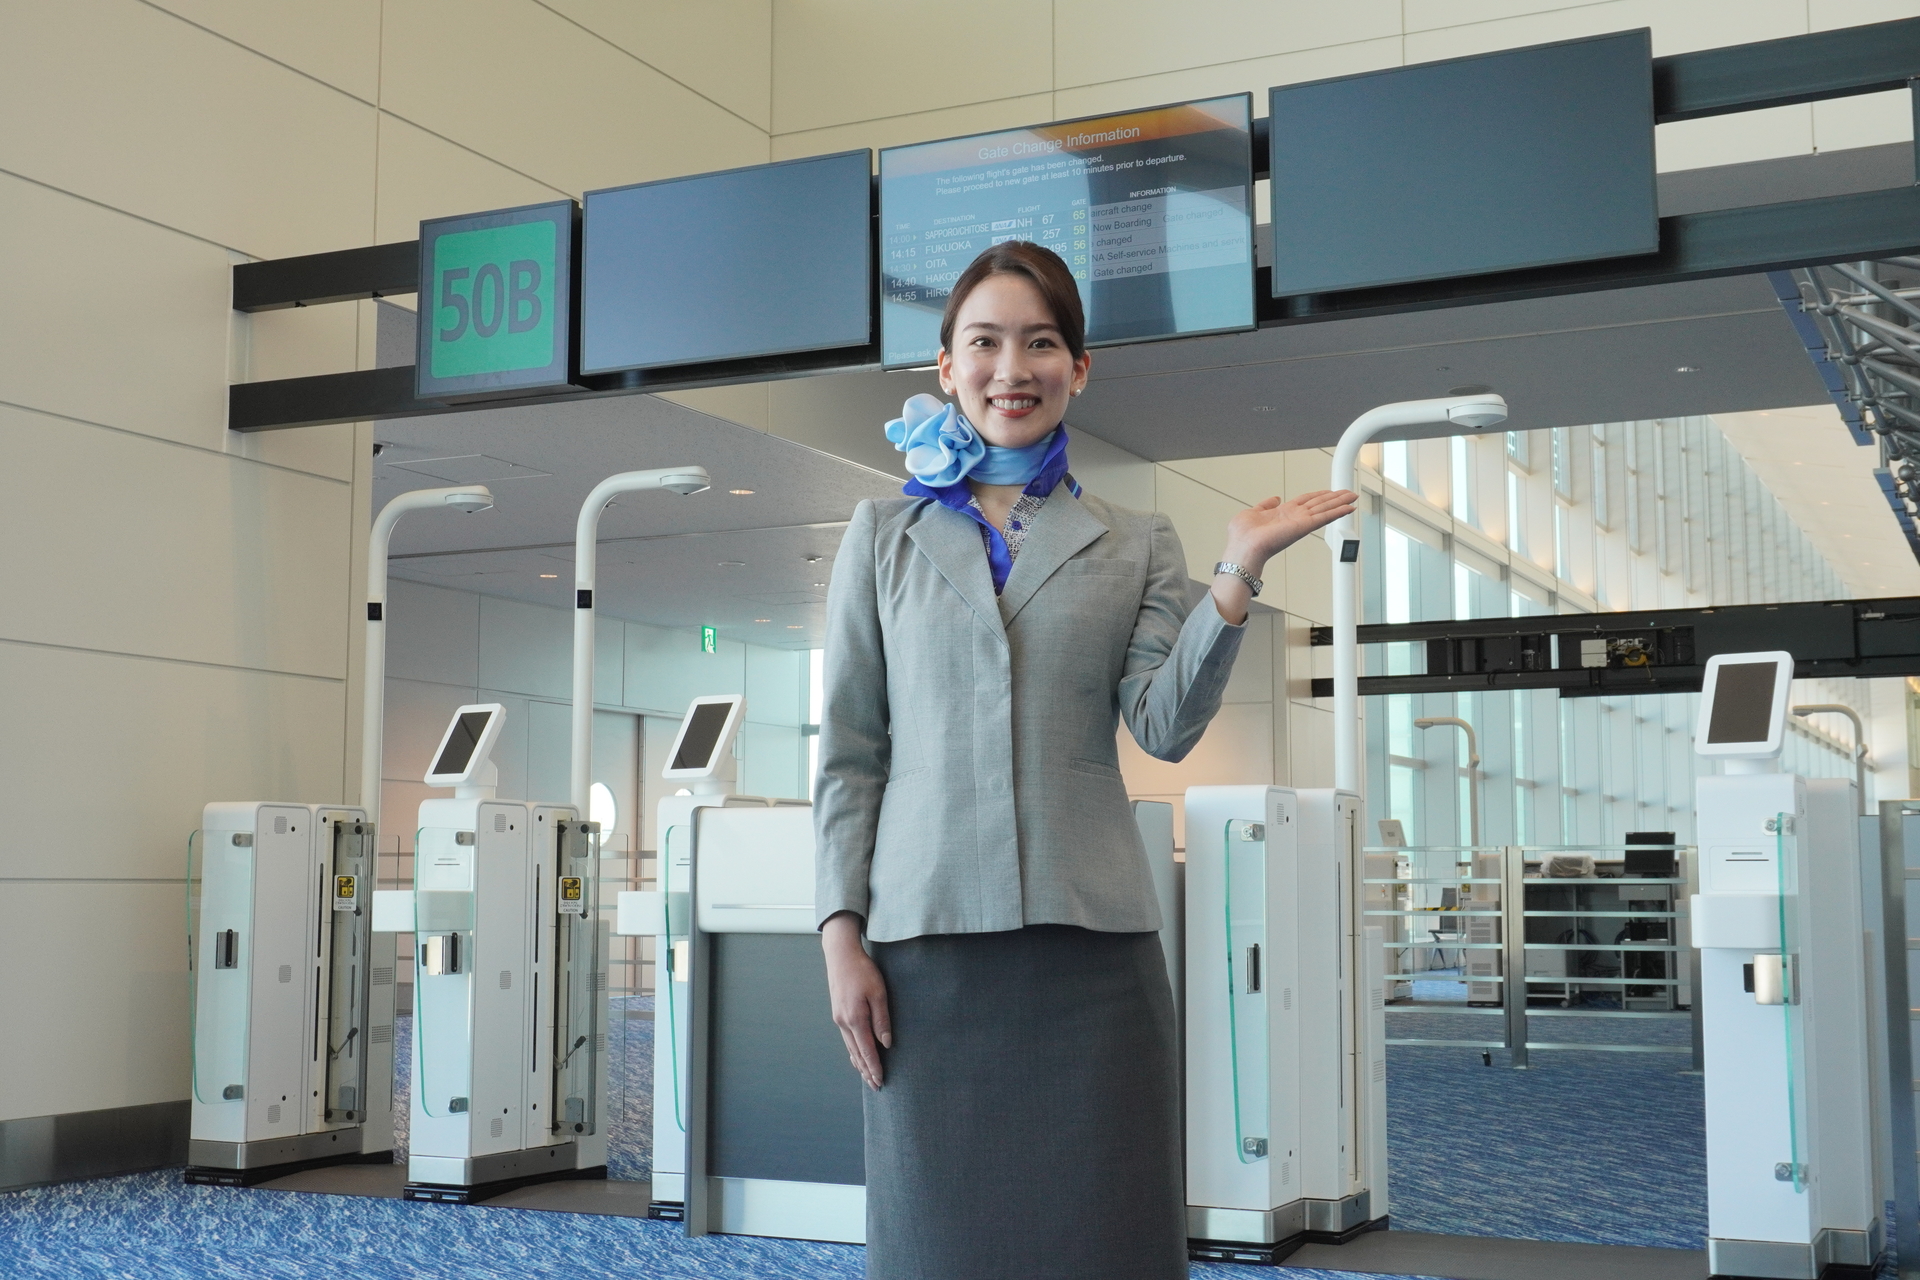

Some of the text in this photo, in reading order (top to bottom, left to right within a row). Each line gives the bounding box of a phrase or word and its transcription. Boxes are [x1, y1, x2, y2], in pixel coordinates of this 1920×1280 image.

[979, 127, 1140, 160] Gate Change Information
[935, 186, 961, 196] Please
[963, 181, 993, 193] proceed
[1004, 178, 1020, 186] new
[1022, 175, 1039, 185] gate
[1041, 172, 1049, 180] at
[1050, 169, 1069, 180] least
[1072, 167, 1081, 177] 10
[1083, 164, 1114, 175] minutes
[1116, 161, 1134, 171] prior
[1136, 159, 1143, 167] to
[1145, 153, 1187, 166] departure.
[936, 154, 1104, 185] The following flight's gate has been changed.
[1071, 198, 1087, 206] GATE
[1129, 186, 1177, 198] INFORMATION
[933, 214, 975, 225] DESTINATION
[1017, 217, 1033, 228] NH
[1042, 214, 1054, 224] 67
[1073, 209, 1085, 220] 65
[1091, 206, 1119, 217] aircraft
[1121, 203, 1152, 214] change
[1018, 205, 1041, 213] FLIGHT
[891, 247, 916, 259] 14:15
[925, 240, 972, 255] FUKUOKA
[1017, 232, 1033, 242] NH
[1042, 228, 1060, 240] 257
[1073, 225, 1086, 235] 59
[1093, 223, 1111, 232] Now
[1114, 218, 1152, 230] Boarding
[1163, 214, 1183, 222] Gate
[1186, 207, 1223, 220] changed
[896, 222, 911, 230] TIME
[891, 276, 916, 289] 14:40
[925, 270, 964, 284] HAKOD
[1074, 255, 1086, 265] 55
[1107, 247, 1156, 260] Self-service
[1158, 243, 1200, 254] Machines
[1202, 239, 1219, 248] and
[925, 258, 947, 269] OITA
[1073, 240, 1086, 250] 56
[1096, 235, 1132, 247] changed
[891, 290, 916, 302] 14:55
[1074, 269, 1086, 280] 46
[1094, 268, 1114, 278] Gate
[1117, 262, 1152, 275] changed
[439, 258, 542, 343] 50B
[888, 351, 915, 361] Please
[917, 348, 931, 358] ask
